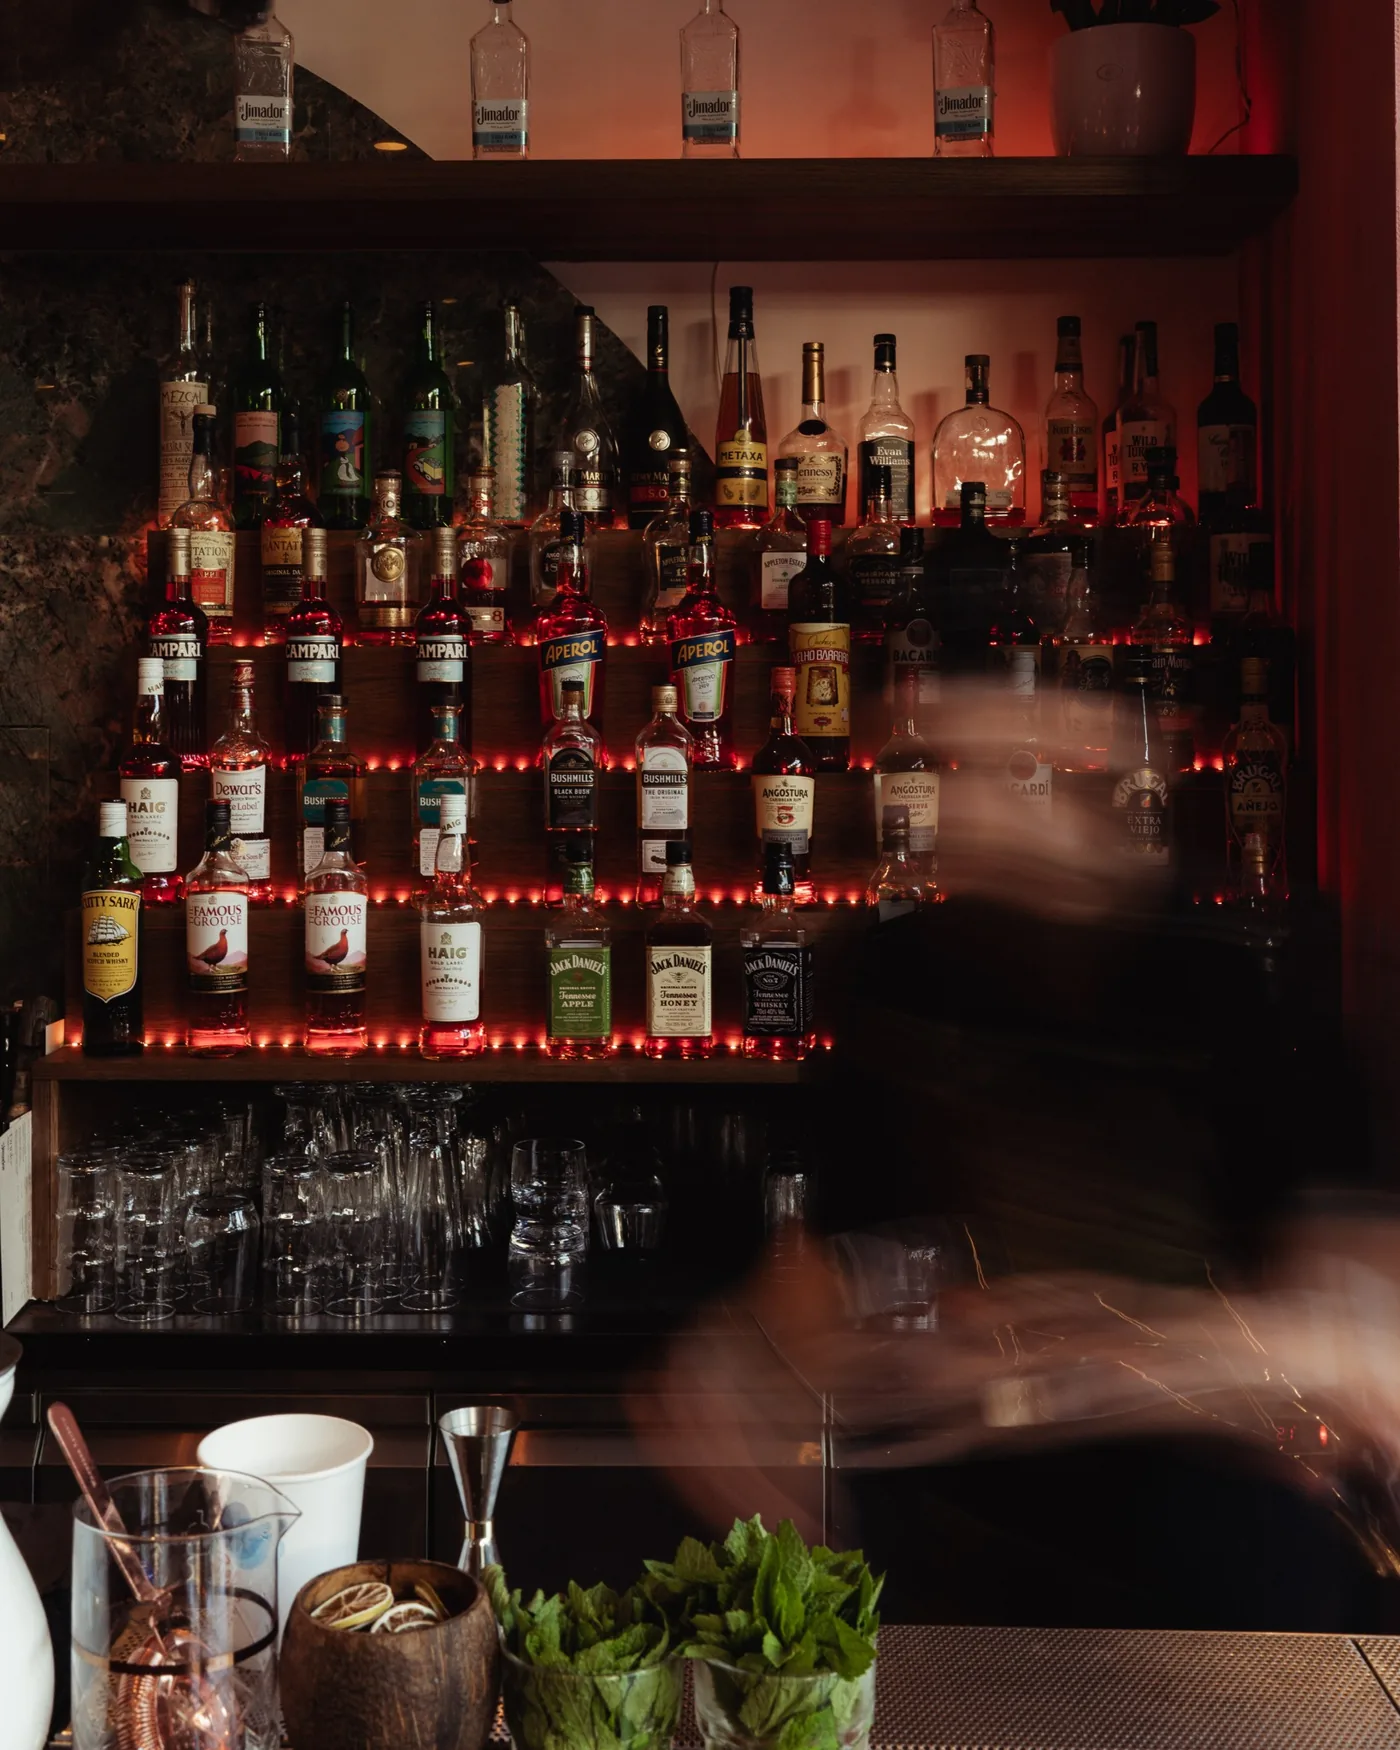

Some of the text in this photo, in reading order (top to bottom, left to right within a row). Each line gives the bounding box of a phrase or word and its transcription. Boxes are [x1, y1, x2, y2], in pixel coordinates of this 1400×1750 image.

[689, 97, 732, 118] Jimador
[941, 93, 985, 115] Jimador
[241, 102, 285, 121] Jimador
[477, 106, 520, 125] Jimador
[162, 391, 206, 405] MEZCAL
[1131, 436, 1158, 447] WILD
[720, 451, 764, 462] METAXA
[877, 446, 903, 456] Evan
[1126, 445, 1149, 460] TUR
[869, 455, 911, 466] Williams
[799, 468, 834, 479] ennessy
[1132, 463, 1149, 476] RY
[192, 547, 228, 558] TATION
[286, 643, 340, 659] CAMPARI
[544, 639, 599, 665] APEROL
[676, 639, 730, 665] APEROL
[892, 650, 934, 662] BACAR
[551, 773, 594, 784] BUSHMILLS
[644, 773, 687, 784] BUSHMILLS
[216, 782, 262, 796] Dewar's
[762, 788, 809, 798] ANGOSTURA
[890, 785, 936, 796] ANGOSTURA
[1111, 768, 1168, 808] BRUGAL
[128, 802, 166, 813] HAIG
[441, 818, 462, 833] HAIG
[1127, 816, 1161, 825] EXTRA
[1130, 826, 1160, 836] VIEJO
[109, 896, 137, 910] SARK
[194, 904, 242, 916] FAMOUS
[314, 904, 362, 917] FAMOUS
[194, 916, 242, 927] GROUSE
[314, 916, 362, 927] GROUSE
[428, 946, 468, 959] HAIG
[551, 955, 607, 976] JACK DANIEL'S
[651, 954, 707, 975] JACK DANIEL'S
[745, 955, 799, 976] JACK DANIEL'S
[559, 991, 597, 1000] Tennessee
[660, 990, 697, 999] Tennessee
[752, 989, 789, 998] Tennessee
[561, 1000, 594, 1008] APPLE
